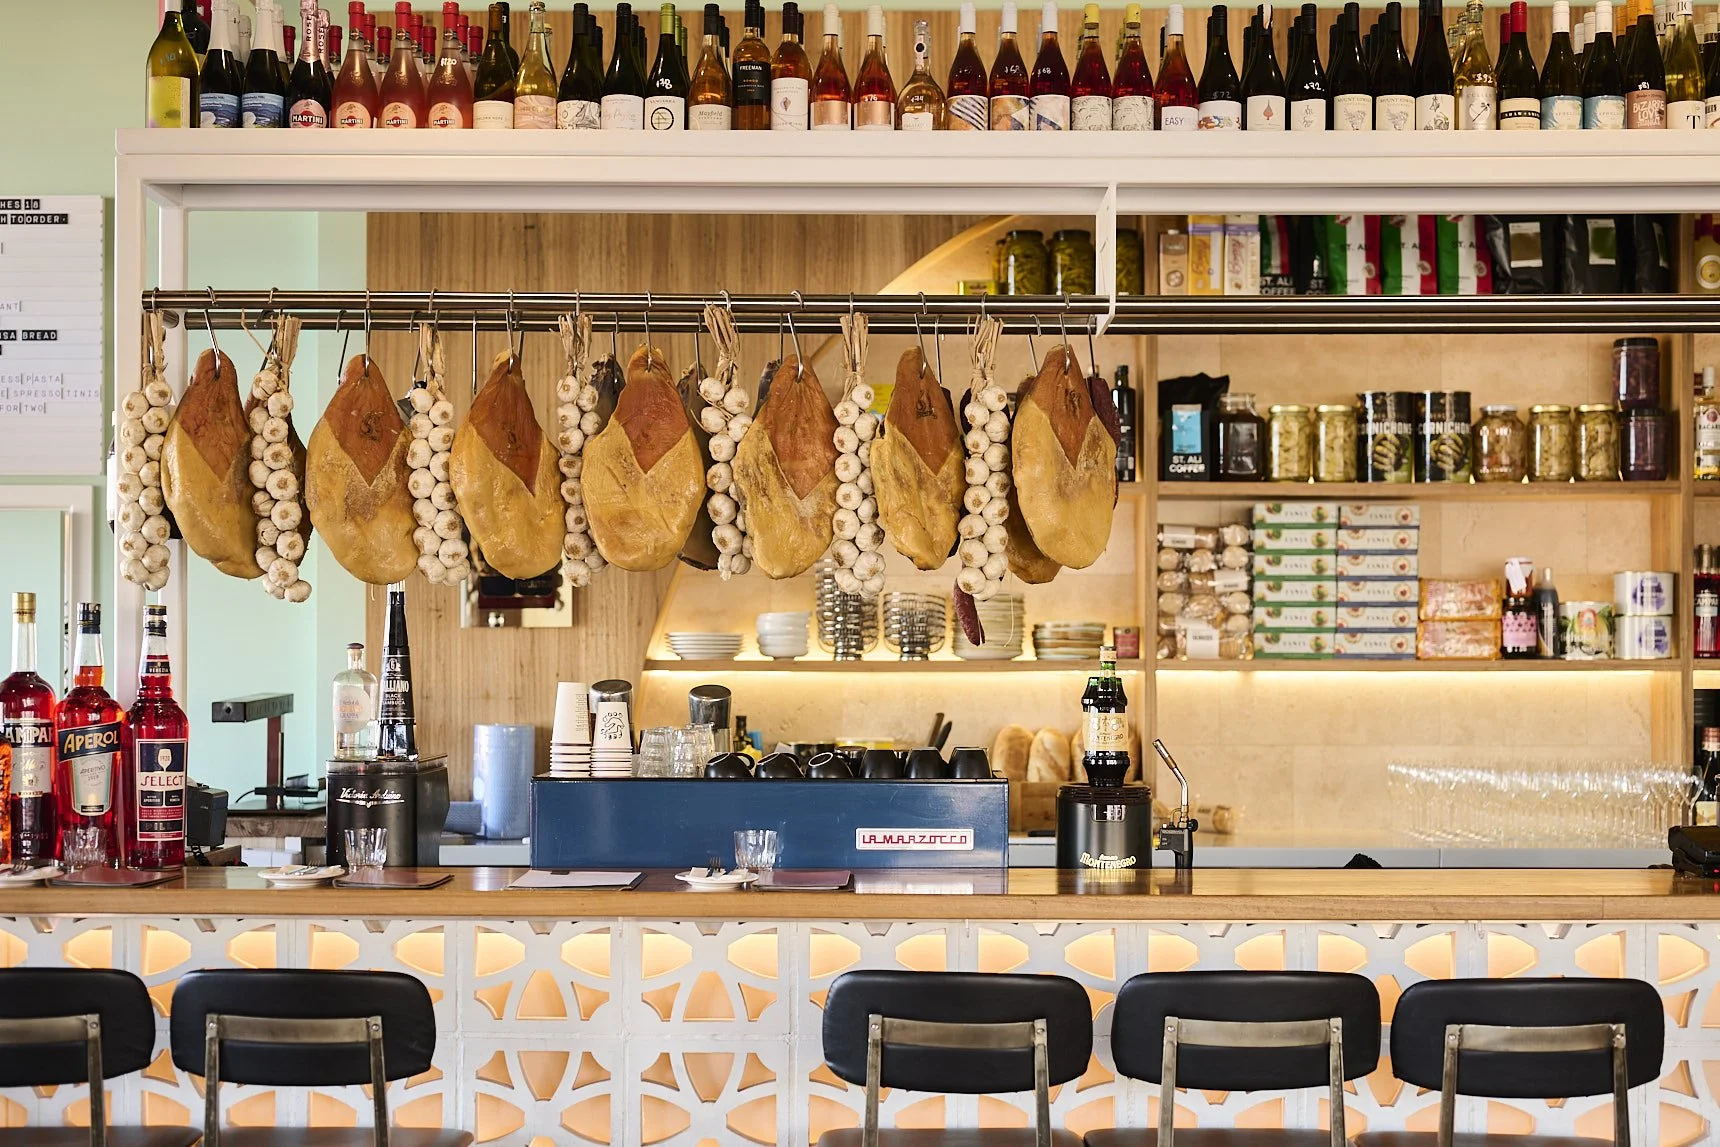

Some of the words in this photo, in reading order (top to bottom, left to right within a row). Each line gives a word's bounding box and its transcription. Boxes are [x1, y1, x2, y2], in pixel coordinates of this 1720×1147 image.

[292, 115, 323, 124] MARTINI
[1165, 117, 1183, 126] EASY
[25, 200, 39, 209] 18
[1261, 287, 1296, 296] OFFEE
[22, 331, 57, 340] BREAD
[1172, 455, 1185, 463] ST.
[1187, 455, 1202, 463] ALI
[1169, 464, 1205, 473] COFFEE
[384, 680, 410, 693] LLIANO
[63, 730, 119, 754] APEROL
[140, 775, 184, 787] SELECT
[862, 834, 877, 844] LA
[882, 834, 967, 844] MARZOCCO
[1080, 852, 1137, 869] MONTENEGRO
